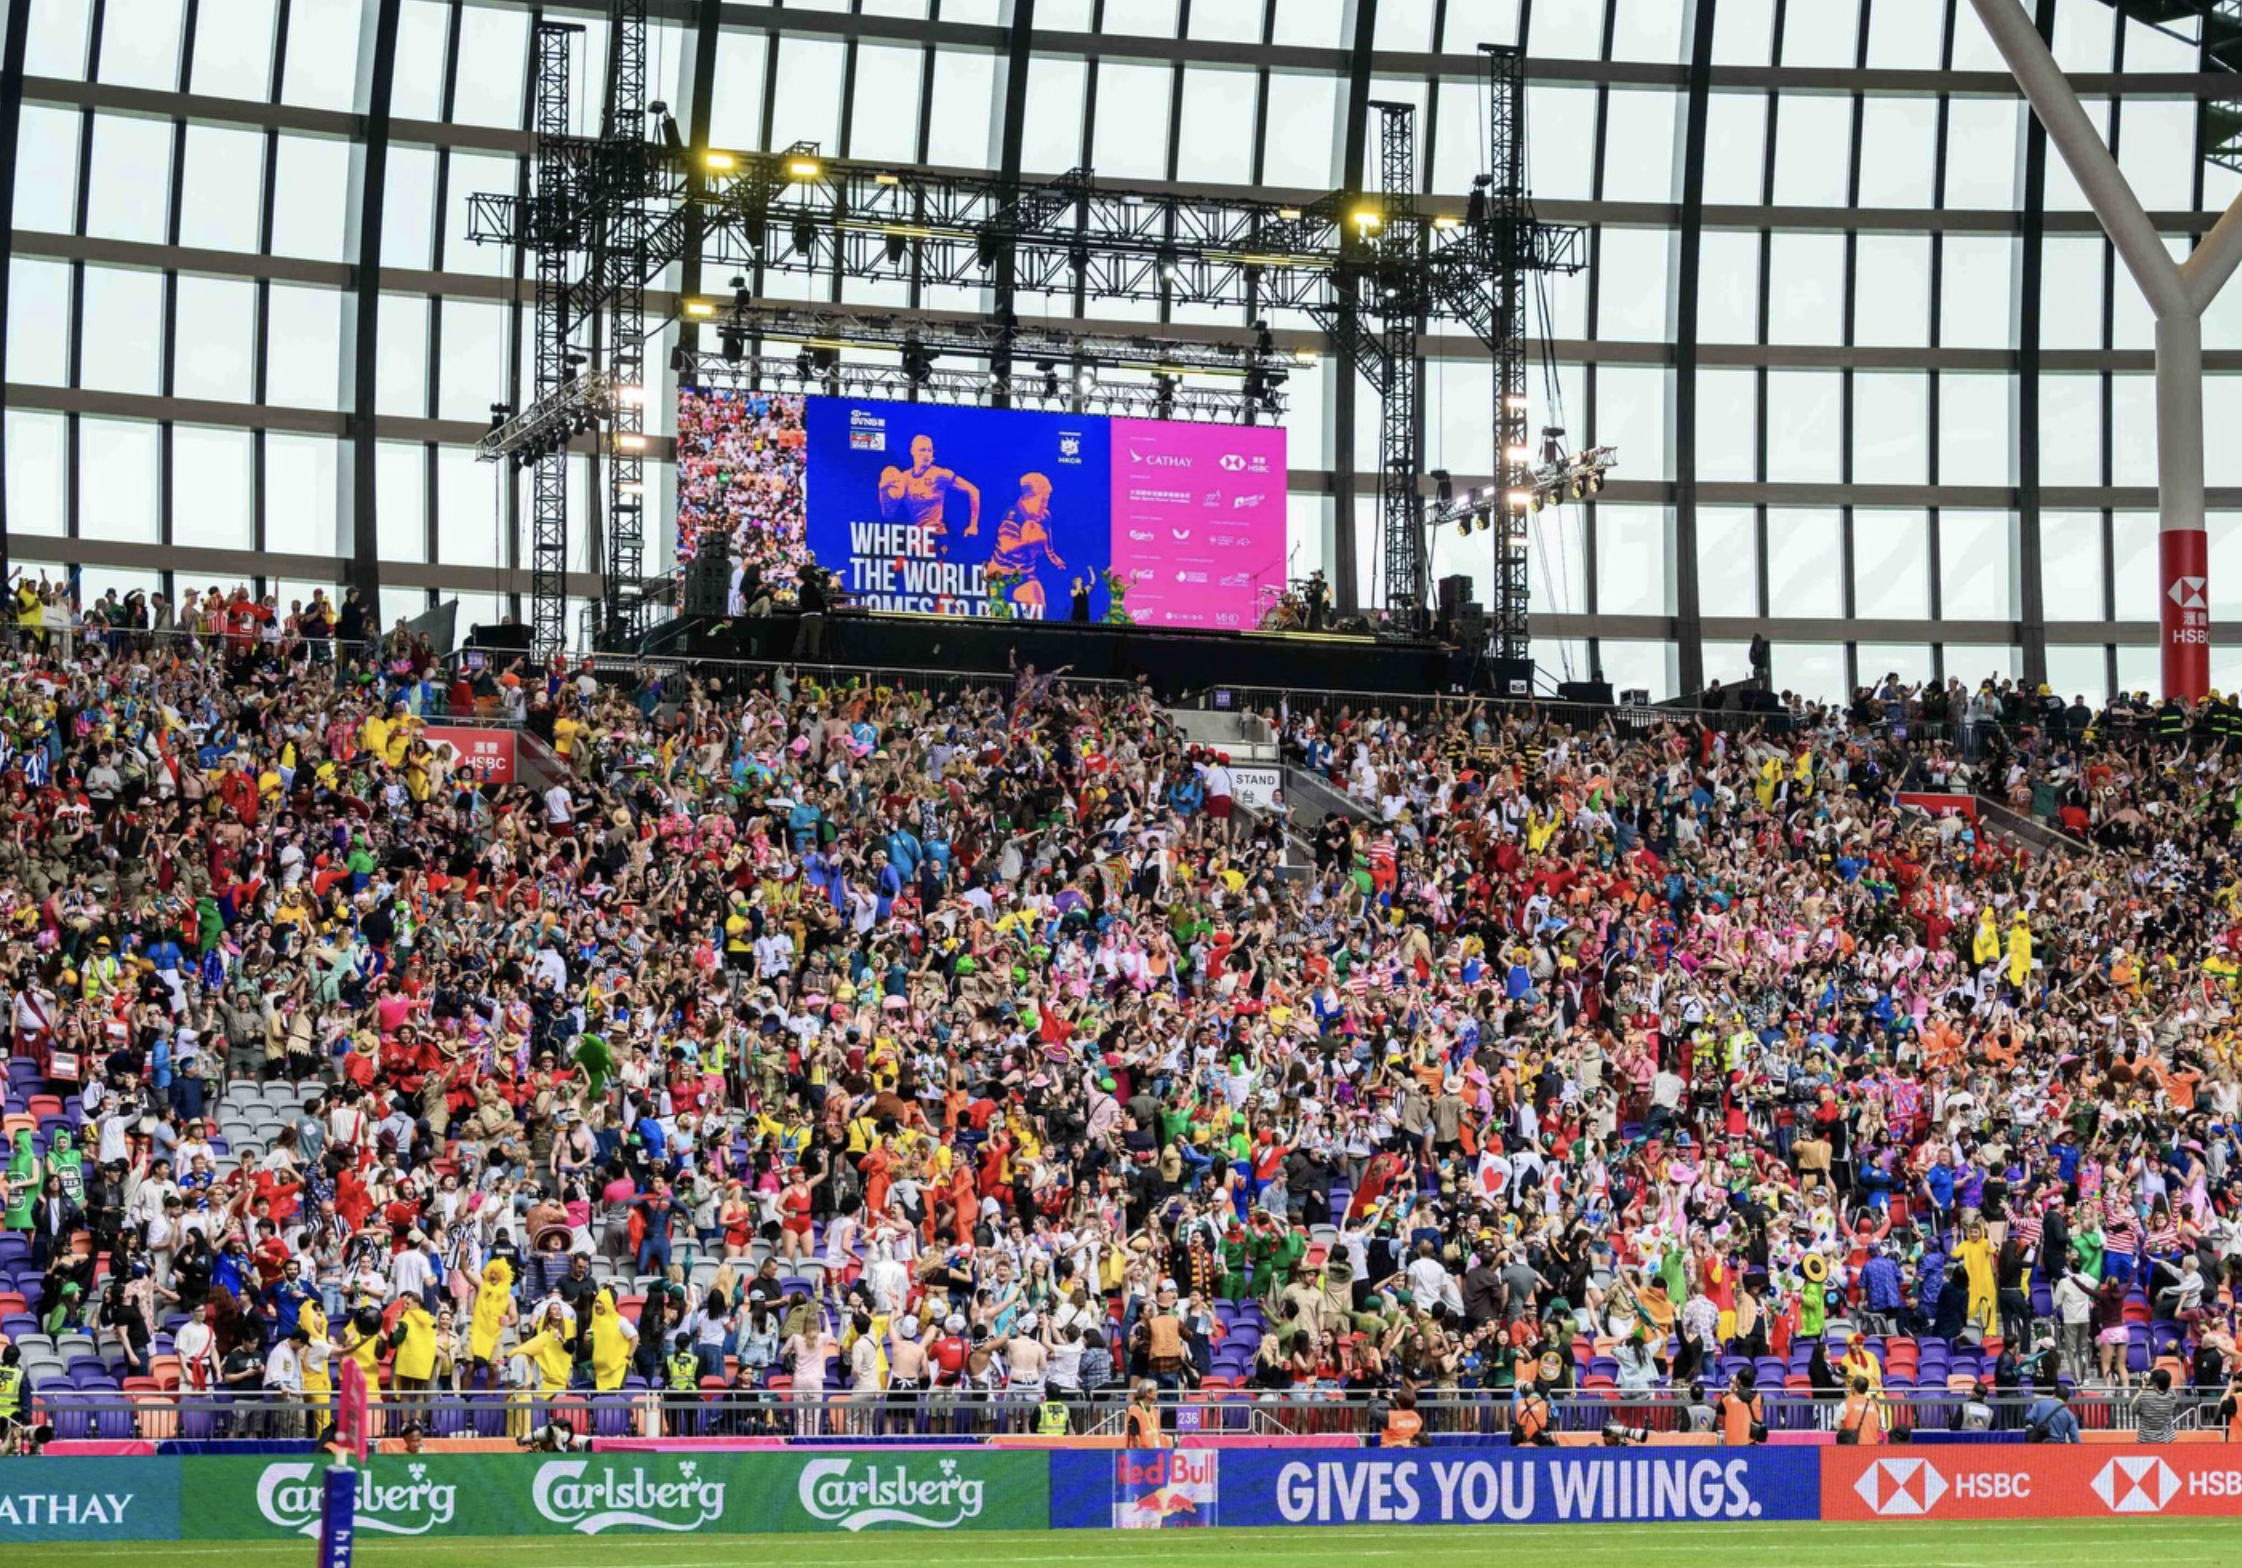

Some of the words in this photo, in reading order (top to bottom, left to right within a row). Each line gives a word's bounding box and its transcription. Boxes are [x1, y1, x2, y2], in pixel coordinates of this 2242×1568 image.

[1146, 455, 1193, 468] CATHAY
[850, 521, 937, 558] WHERE
[850, 557, 897, 592] THE
[903, 560, 988, 597] WORLD
[465, 756, 506, 770] HSBC
[1236, 774, 1275, 785] STAND
[1178, 1411, 1199, 1425] 236
[1117, 1453, 1165, 1485] Red
[1170, 1453, 1216, 1484] Bull
[1956, 1472, 2031, 1498] HSBC
[2189, 1471, 2242, 1496] HSB
[256, 1462, 456, 1527] Carberg
[532, 1460, 725, 1524] Carlsberg
[799, 1458, 984, 1521] Carlsberg
[1276, 1461, 1420, 1522] GIVES
[1431, 1460, 1536, 1521] YOU
[1549, 1459, 1762, 1519] WIIINGS.
